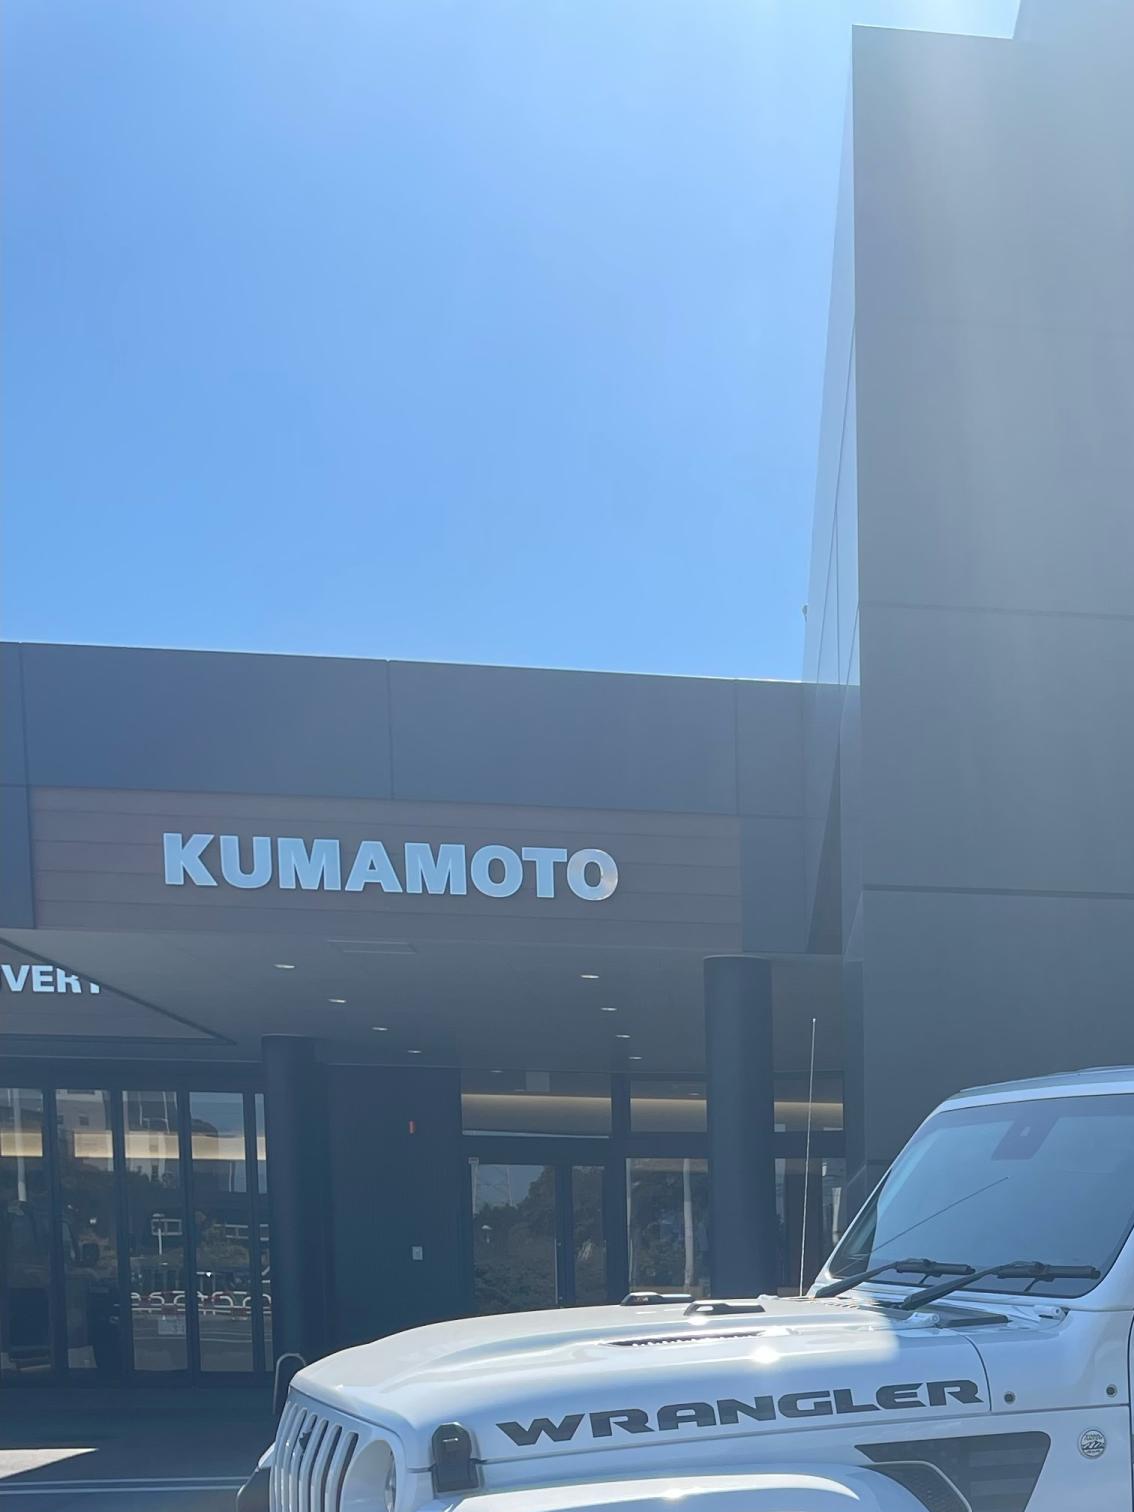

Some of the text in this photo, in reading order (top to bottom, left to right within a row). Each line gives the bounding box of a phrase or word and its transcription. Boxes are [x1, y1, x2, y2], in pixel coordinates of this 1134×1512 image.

[162, 832, 619, 901] KUMAMOTO
[0, 964, 100, 994] VER
[496, 1379, 984, 1446] WRANGLER
